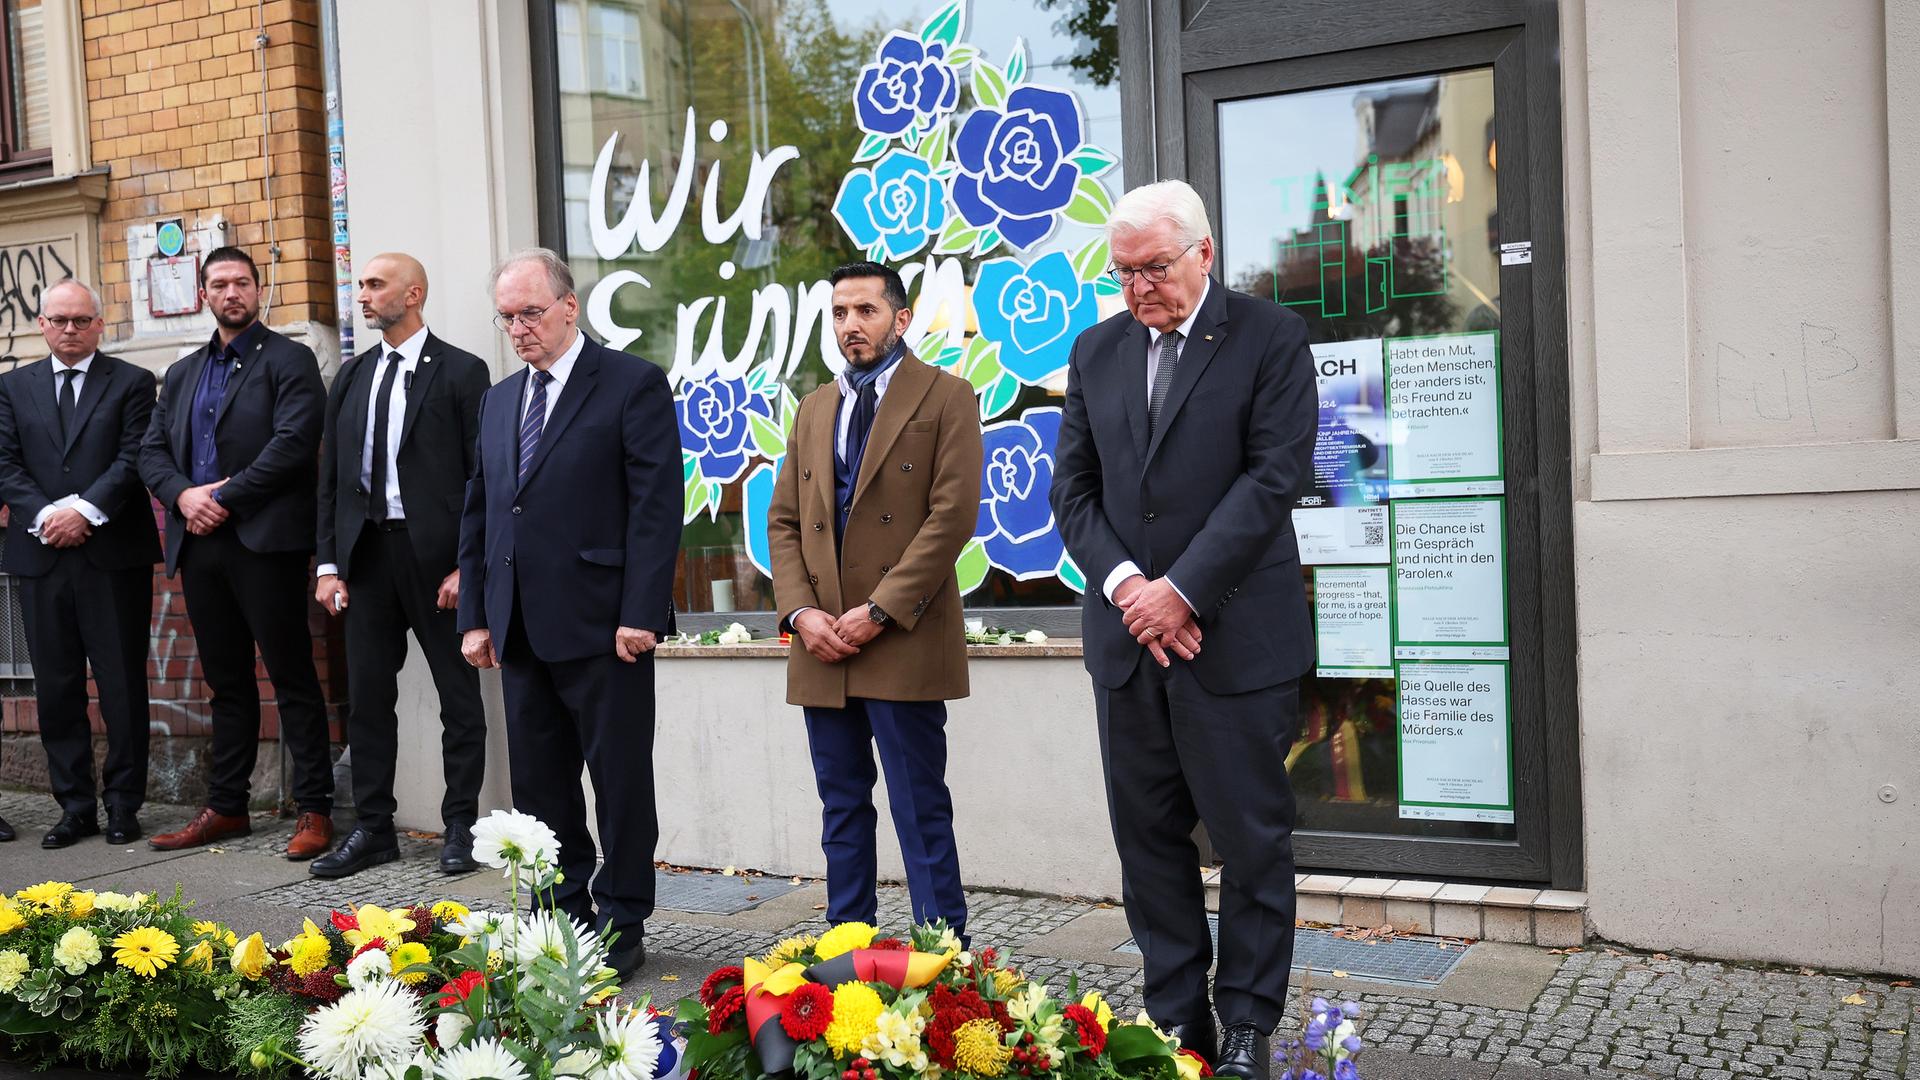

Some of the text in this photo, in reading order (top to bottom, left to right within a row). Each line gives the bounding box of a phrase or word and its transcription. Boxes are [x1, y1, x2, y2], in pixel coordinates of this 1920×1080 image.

[588, 105, 801, 261] Wir
[1390, 344, 1476, 360] Habt den Mut,
[1389, 359, 1496, 377] jeden Menschen,
[1390, 379, 1411, 390] der
[1391, 391, 1472, 404] als Freund zu
[1396, 522, 1485, 535] Die Chance ist
[1397, 538, 1474, 551] im Gespräch
[1397, 552, 1495, 564] und nicht in den
[1397, 568, 1453, 579] Parolen.«
[1317, 580, 1367, 588] Incremental
[1318, 591, 1355, 600] progress
[1364, 591, 1383, 599] that,
[1318, 601, 1329, 609] for
[1364, 601, 1387, 610] great
[1318, 611, 1383, 620] source of hope.
[1401, 680, 1491, 692] Die Quelle des
[1401, 695, 1472, 707] Hasses war
[1402, 709, 1494, 722] die Familie des
[1402, 724, 1463, 736] Mörders.«
